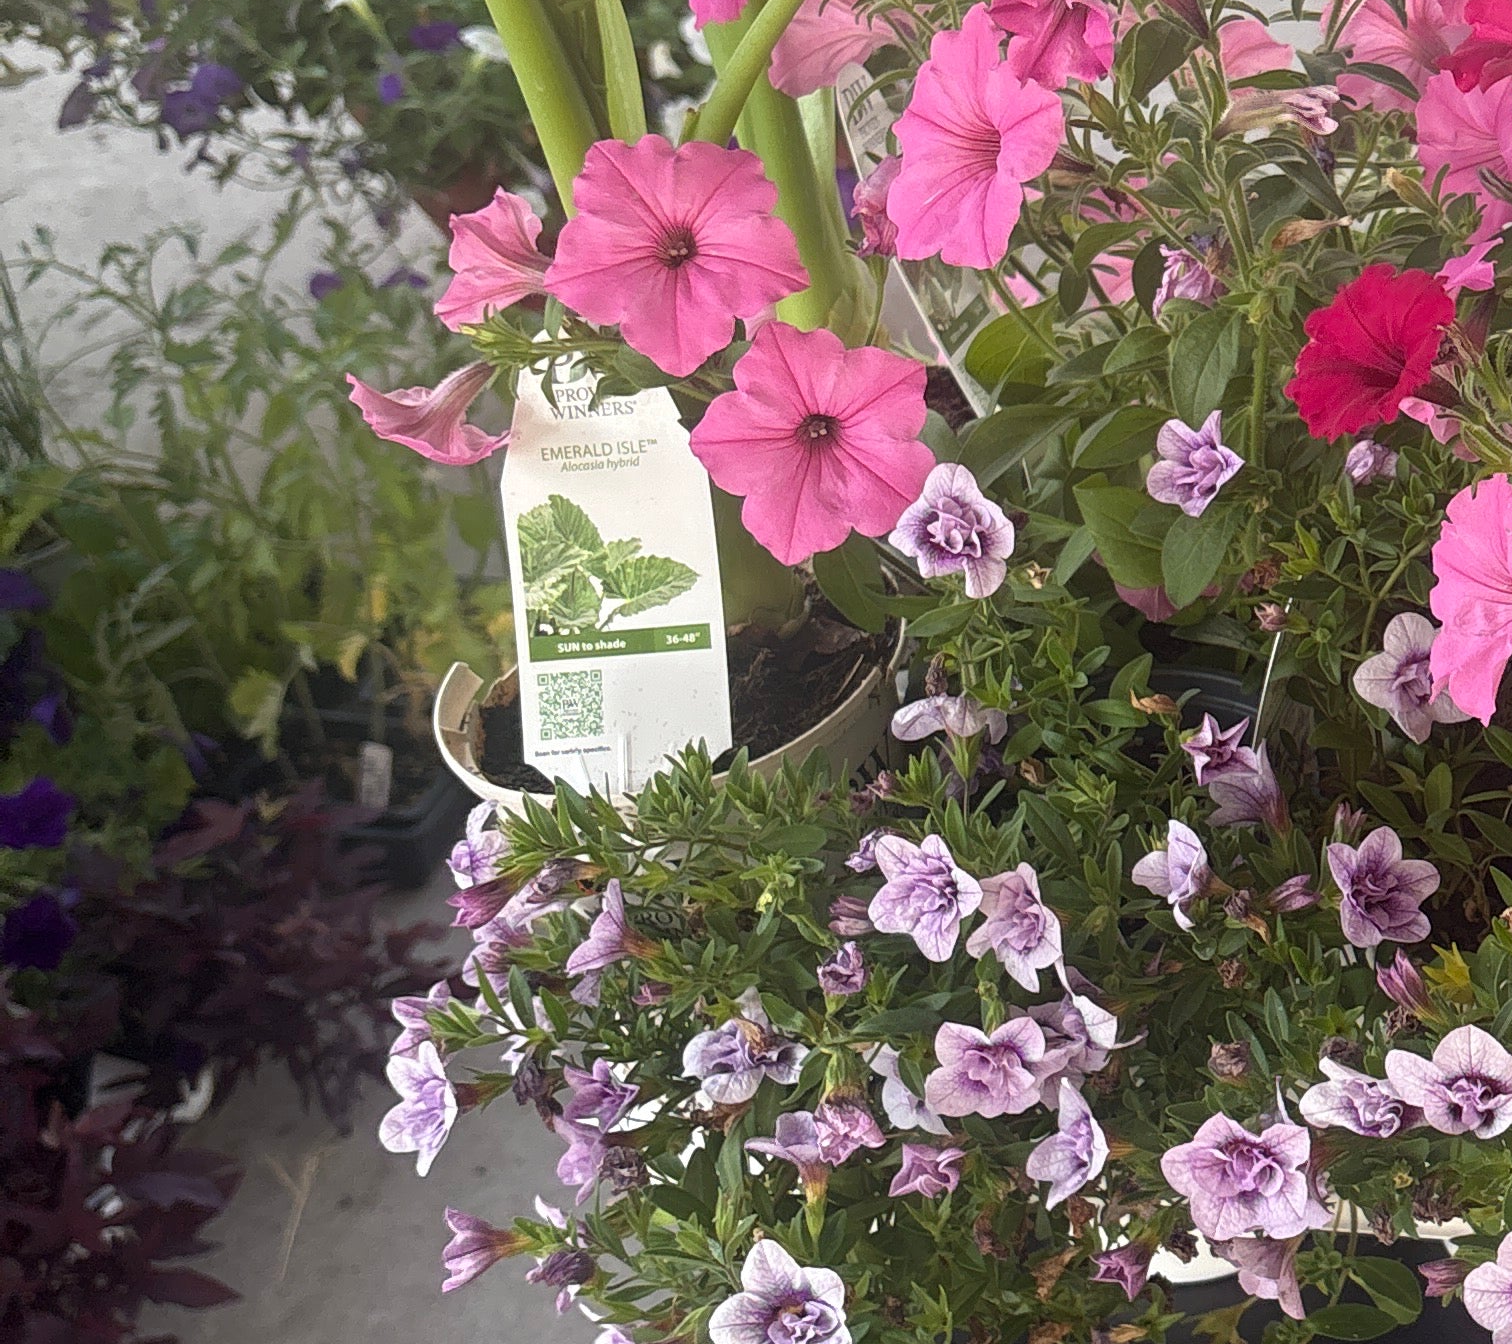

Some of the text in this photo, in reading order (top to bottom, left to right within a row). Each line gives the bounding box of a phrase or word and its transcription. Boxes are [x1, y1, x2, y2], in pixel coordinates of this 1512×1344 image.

[541, 442, 613, 461] EMERALD
[561, 456, 640, 472] Alocasia hybrid
[557, 639, 627, 653] SUN to shade
